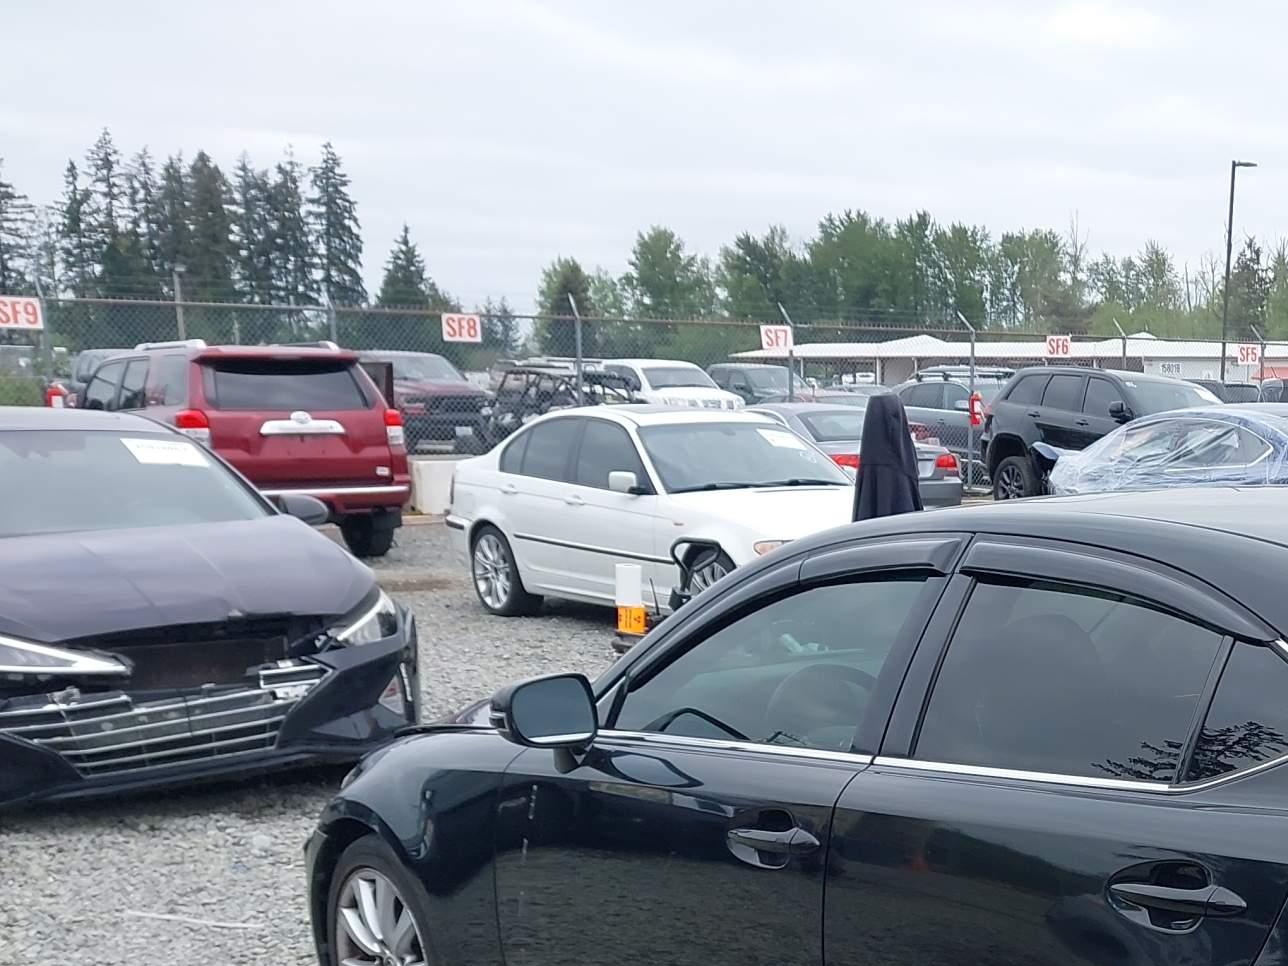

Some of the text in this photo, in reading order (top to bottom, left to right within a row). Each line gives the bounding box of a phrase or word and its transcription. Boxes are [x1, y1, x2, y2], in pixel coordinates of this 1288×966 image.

[0, 301, 38, 325] SF9
[446, 316, 478, 338] SF8
[765, 330, 788, 347] SF7
[1048, 338, 1068, 354] SF6
[1239, 347, 1257, 362] SF5
